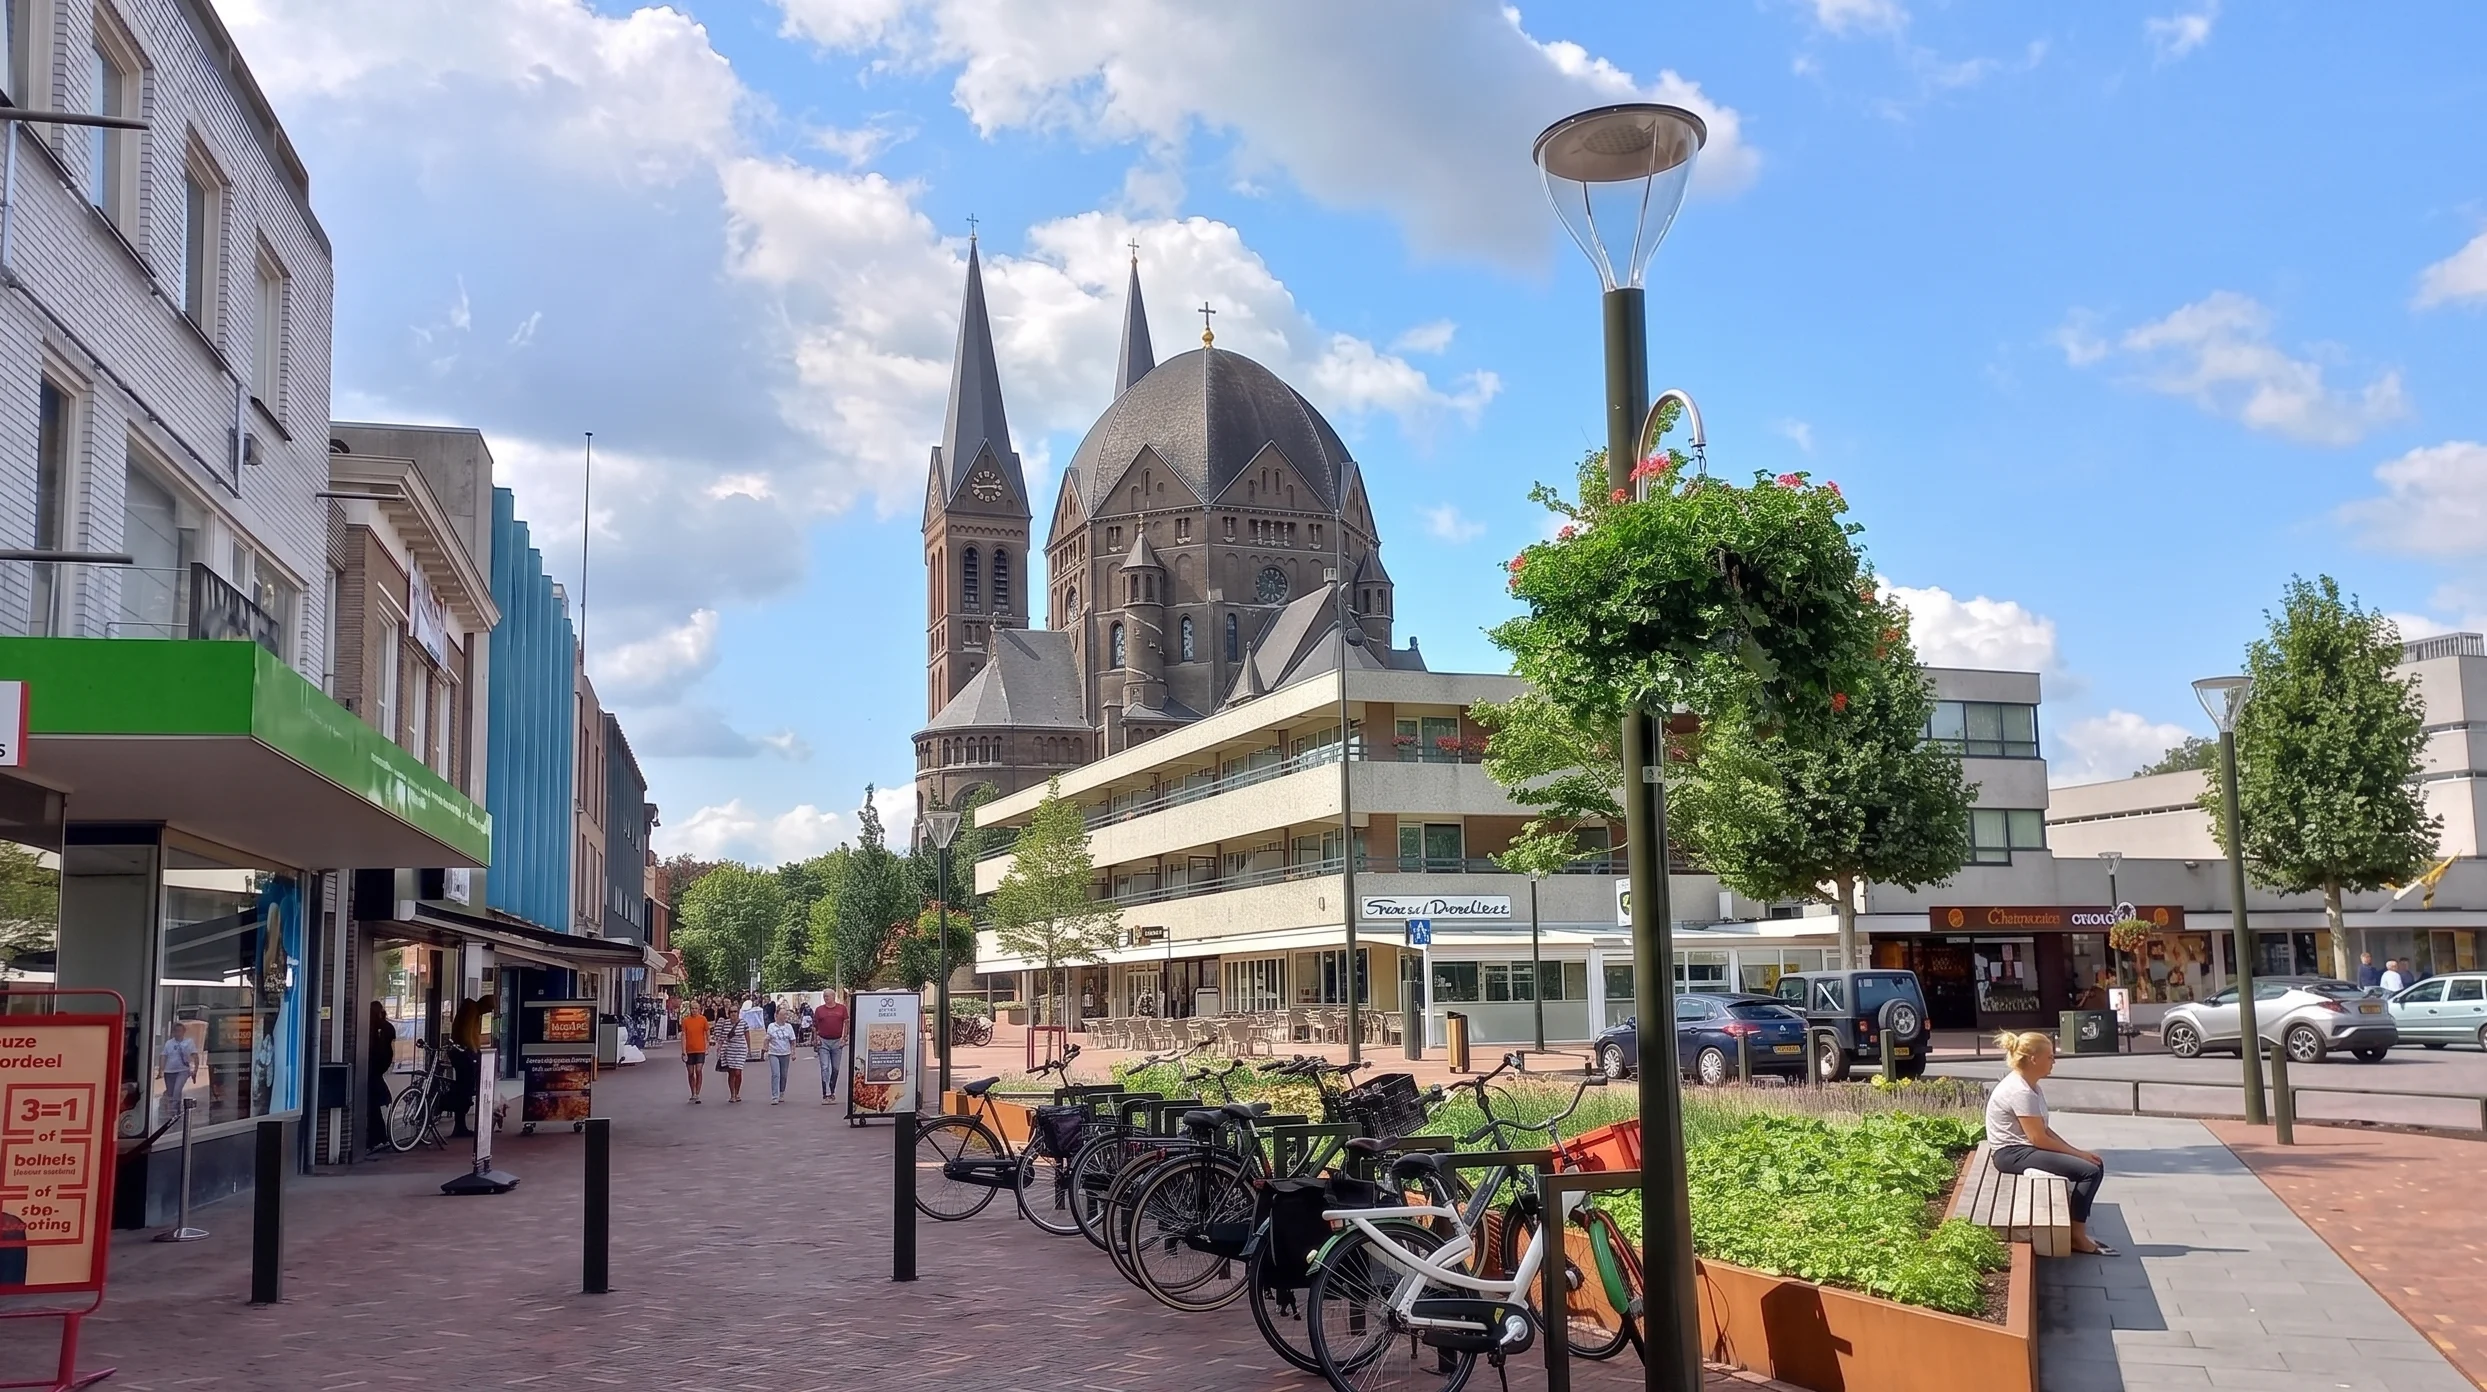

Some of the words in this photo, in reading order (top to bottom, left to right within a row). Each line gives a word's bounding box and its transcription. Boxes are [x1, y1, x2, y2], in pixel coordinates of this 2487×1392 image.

[0, 1037, 37, 1048] uze
[20, 1097, 78, 1122] 3=1
[38, 1130, 56, 1142] of
[34, 1185, 52, 1197] of
